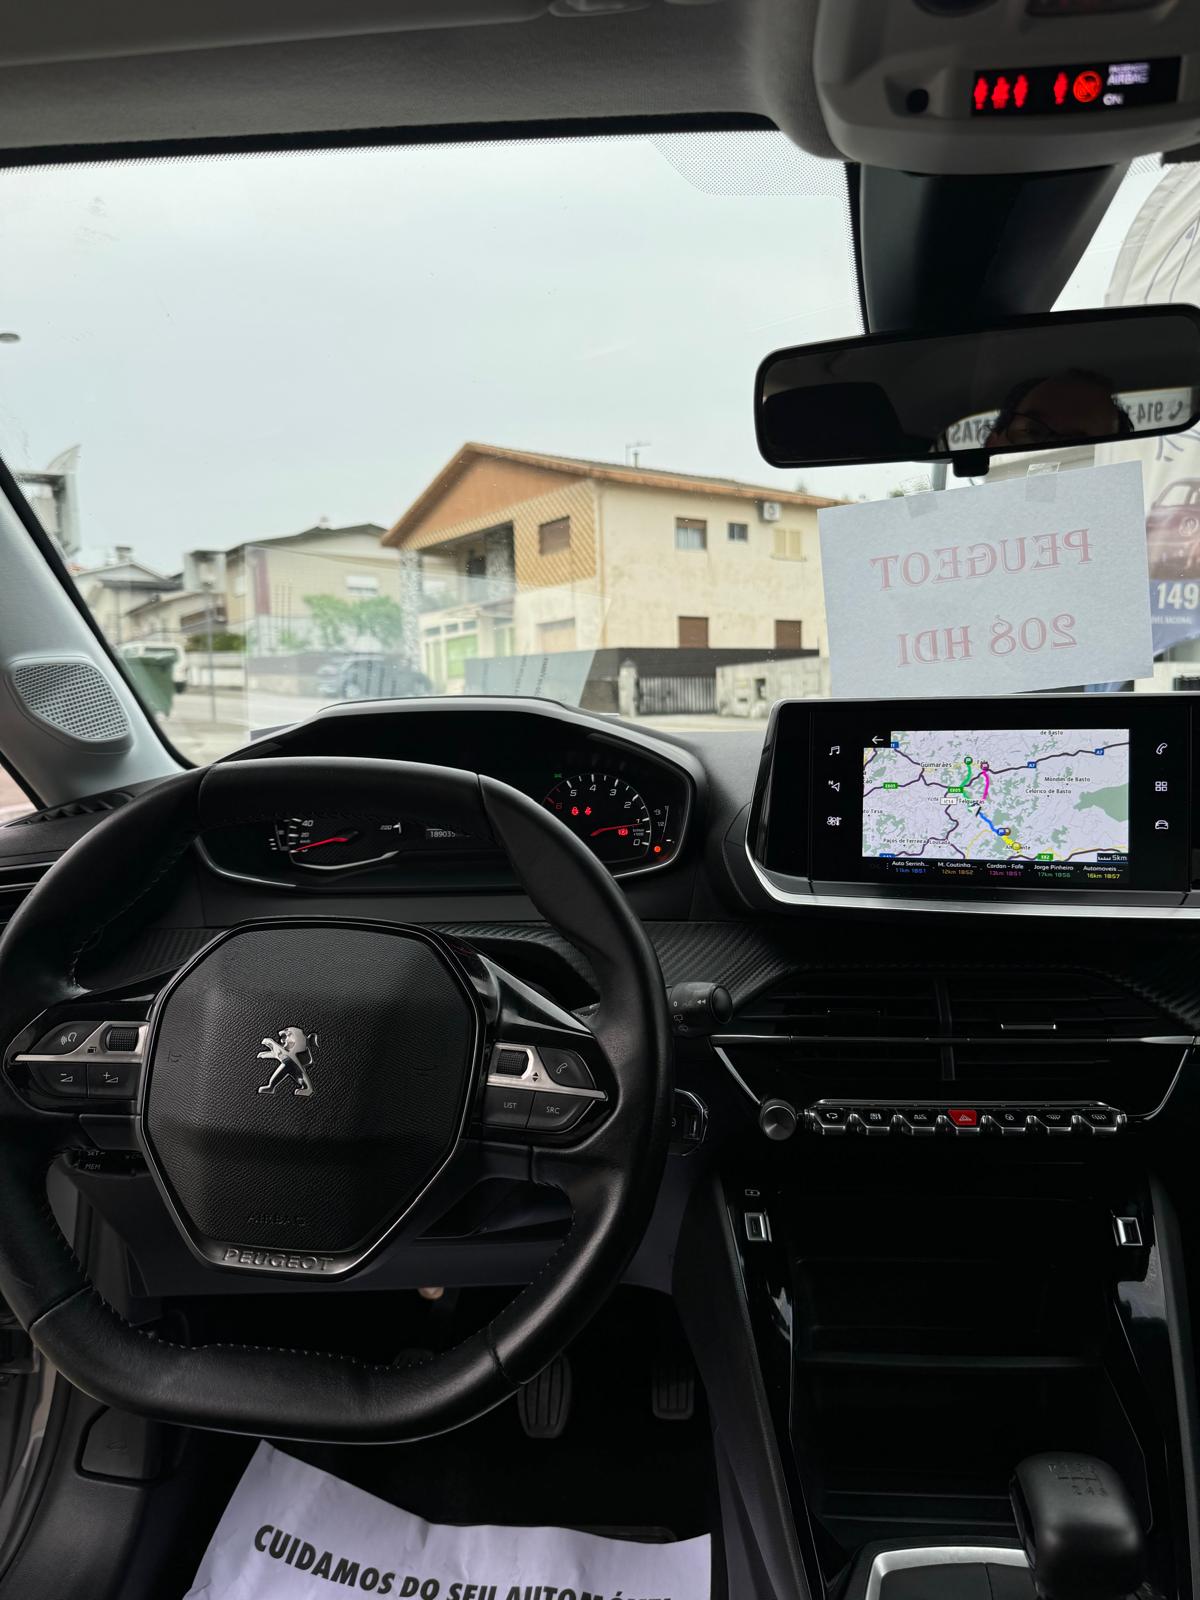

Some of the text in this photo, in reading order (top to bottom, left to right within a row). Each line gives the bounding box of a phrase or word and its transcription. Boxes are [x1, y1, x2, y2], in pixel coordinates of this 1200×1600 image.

[1103, 93, 1123, 106] ON
[590, 784, 597, 792] 4
[610, 788, 617, 796] 3
[570, 789, 577, 797] 5
[624, 801, 632, 809] 2
[302, 819, 314, 828] 40
[632, 838, 641, 846] 0
[546, 1106, 560, 1114] SRC
[223, 1248, 336, 1271] PEUGEOT
[254, 1524, 396, 1594] CUIDAMOS
[400, 1576, 440, 1600] DO
